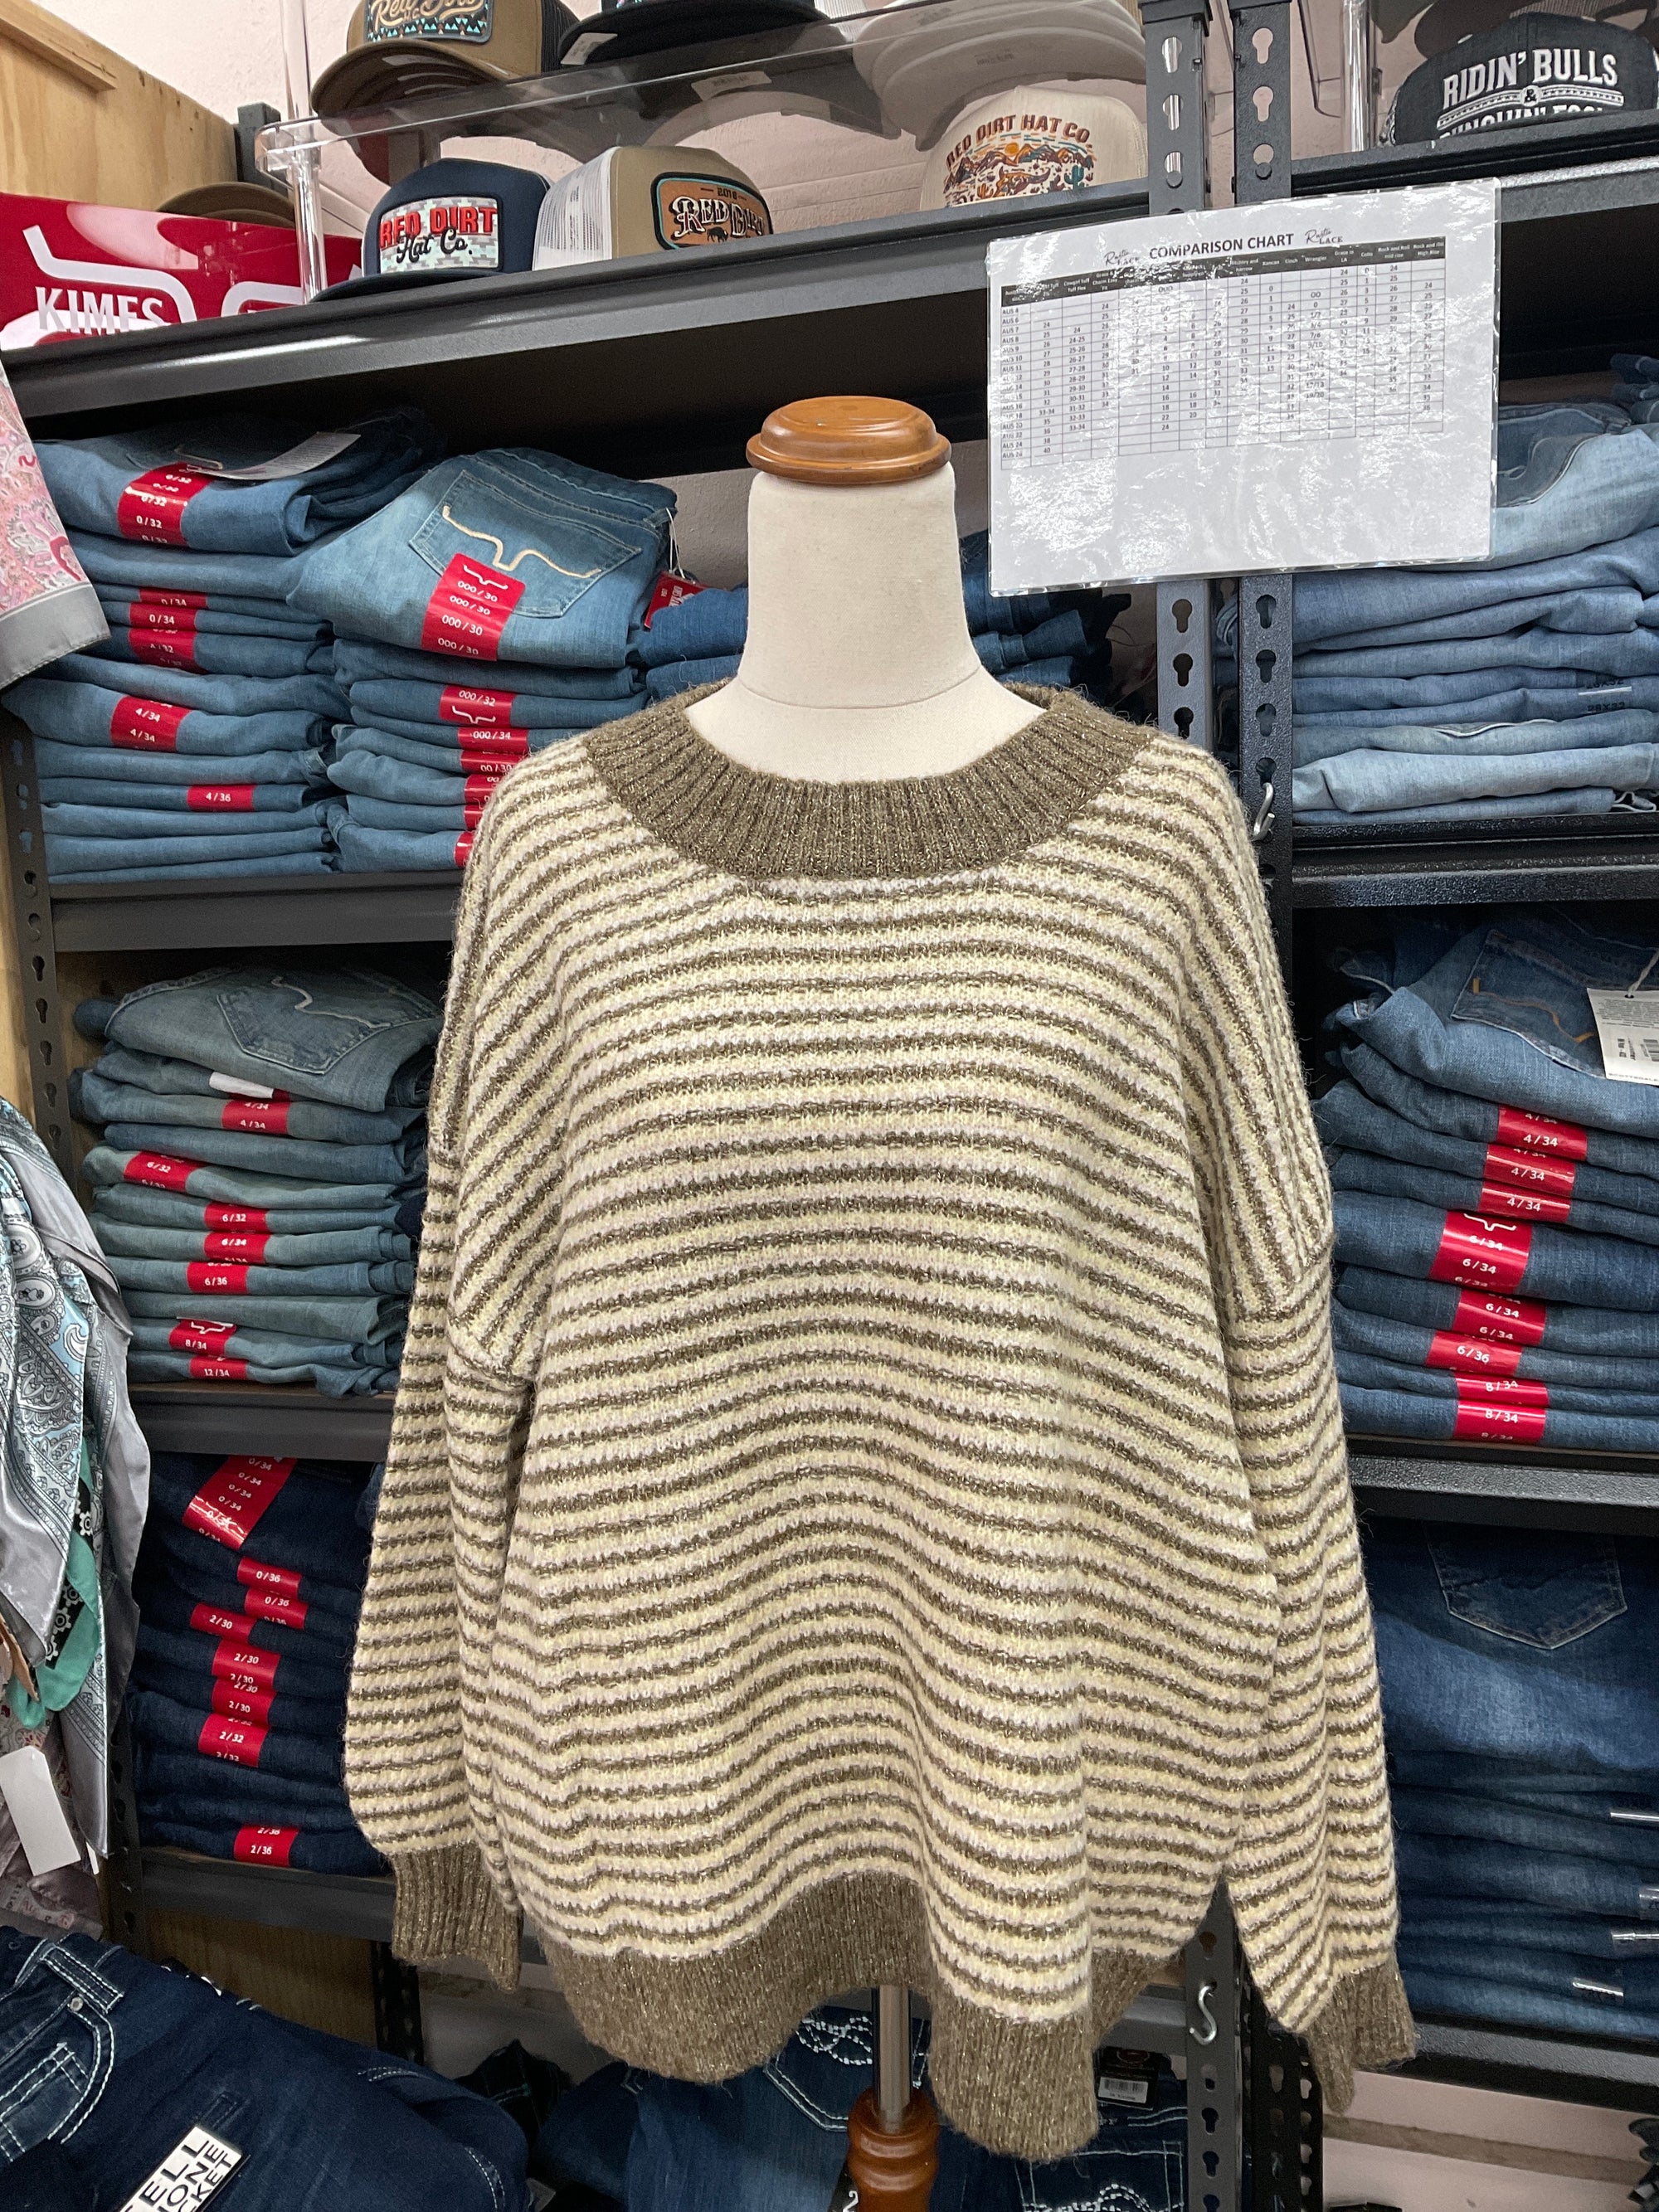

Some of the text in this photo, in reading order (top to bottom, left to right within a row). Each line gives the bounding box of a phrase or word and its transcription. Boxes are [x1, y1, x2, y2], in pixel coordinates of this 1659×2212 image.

[1443, 48, 1618, 109] RIDIN' BULLS
[946, 134, 971, 169] RED
[975, 114, 1016, 143] DIRT
[1021, 114, 1062, 133] HAT
[380, 207, 498, 249] RED DIRT
[671, 196, 730, 238] RED
[397, 234, 435, 264] Hat
[1149, 234, 1294, 259] COMPARISON CHART
[1320, 236, 1343, 245] LACE
[35, 287, 165, 336] KIMES
